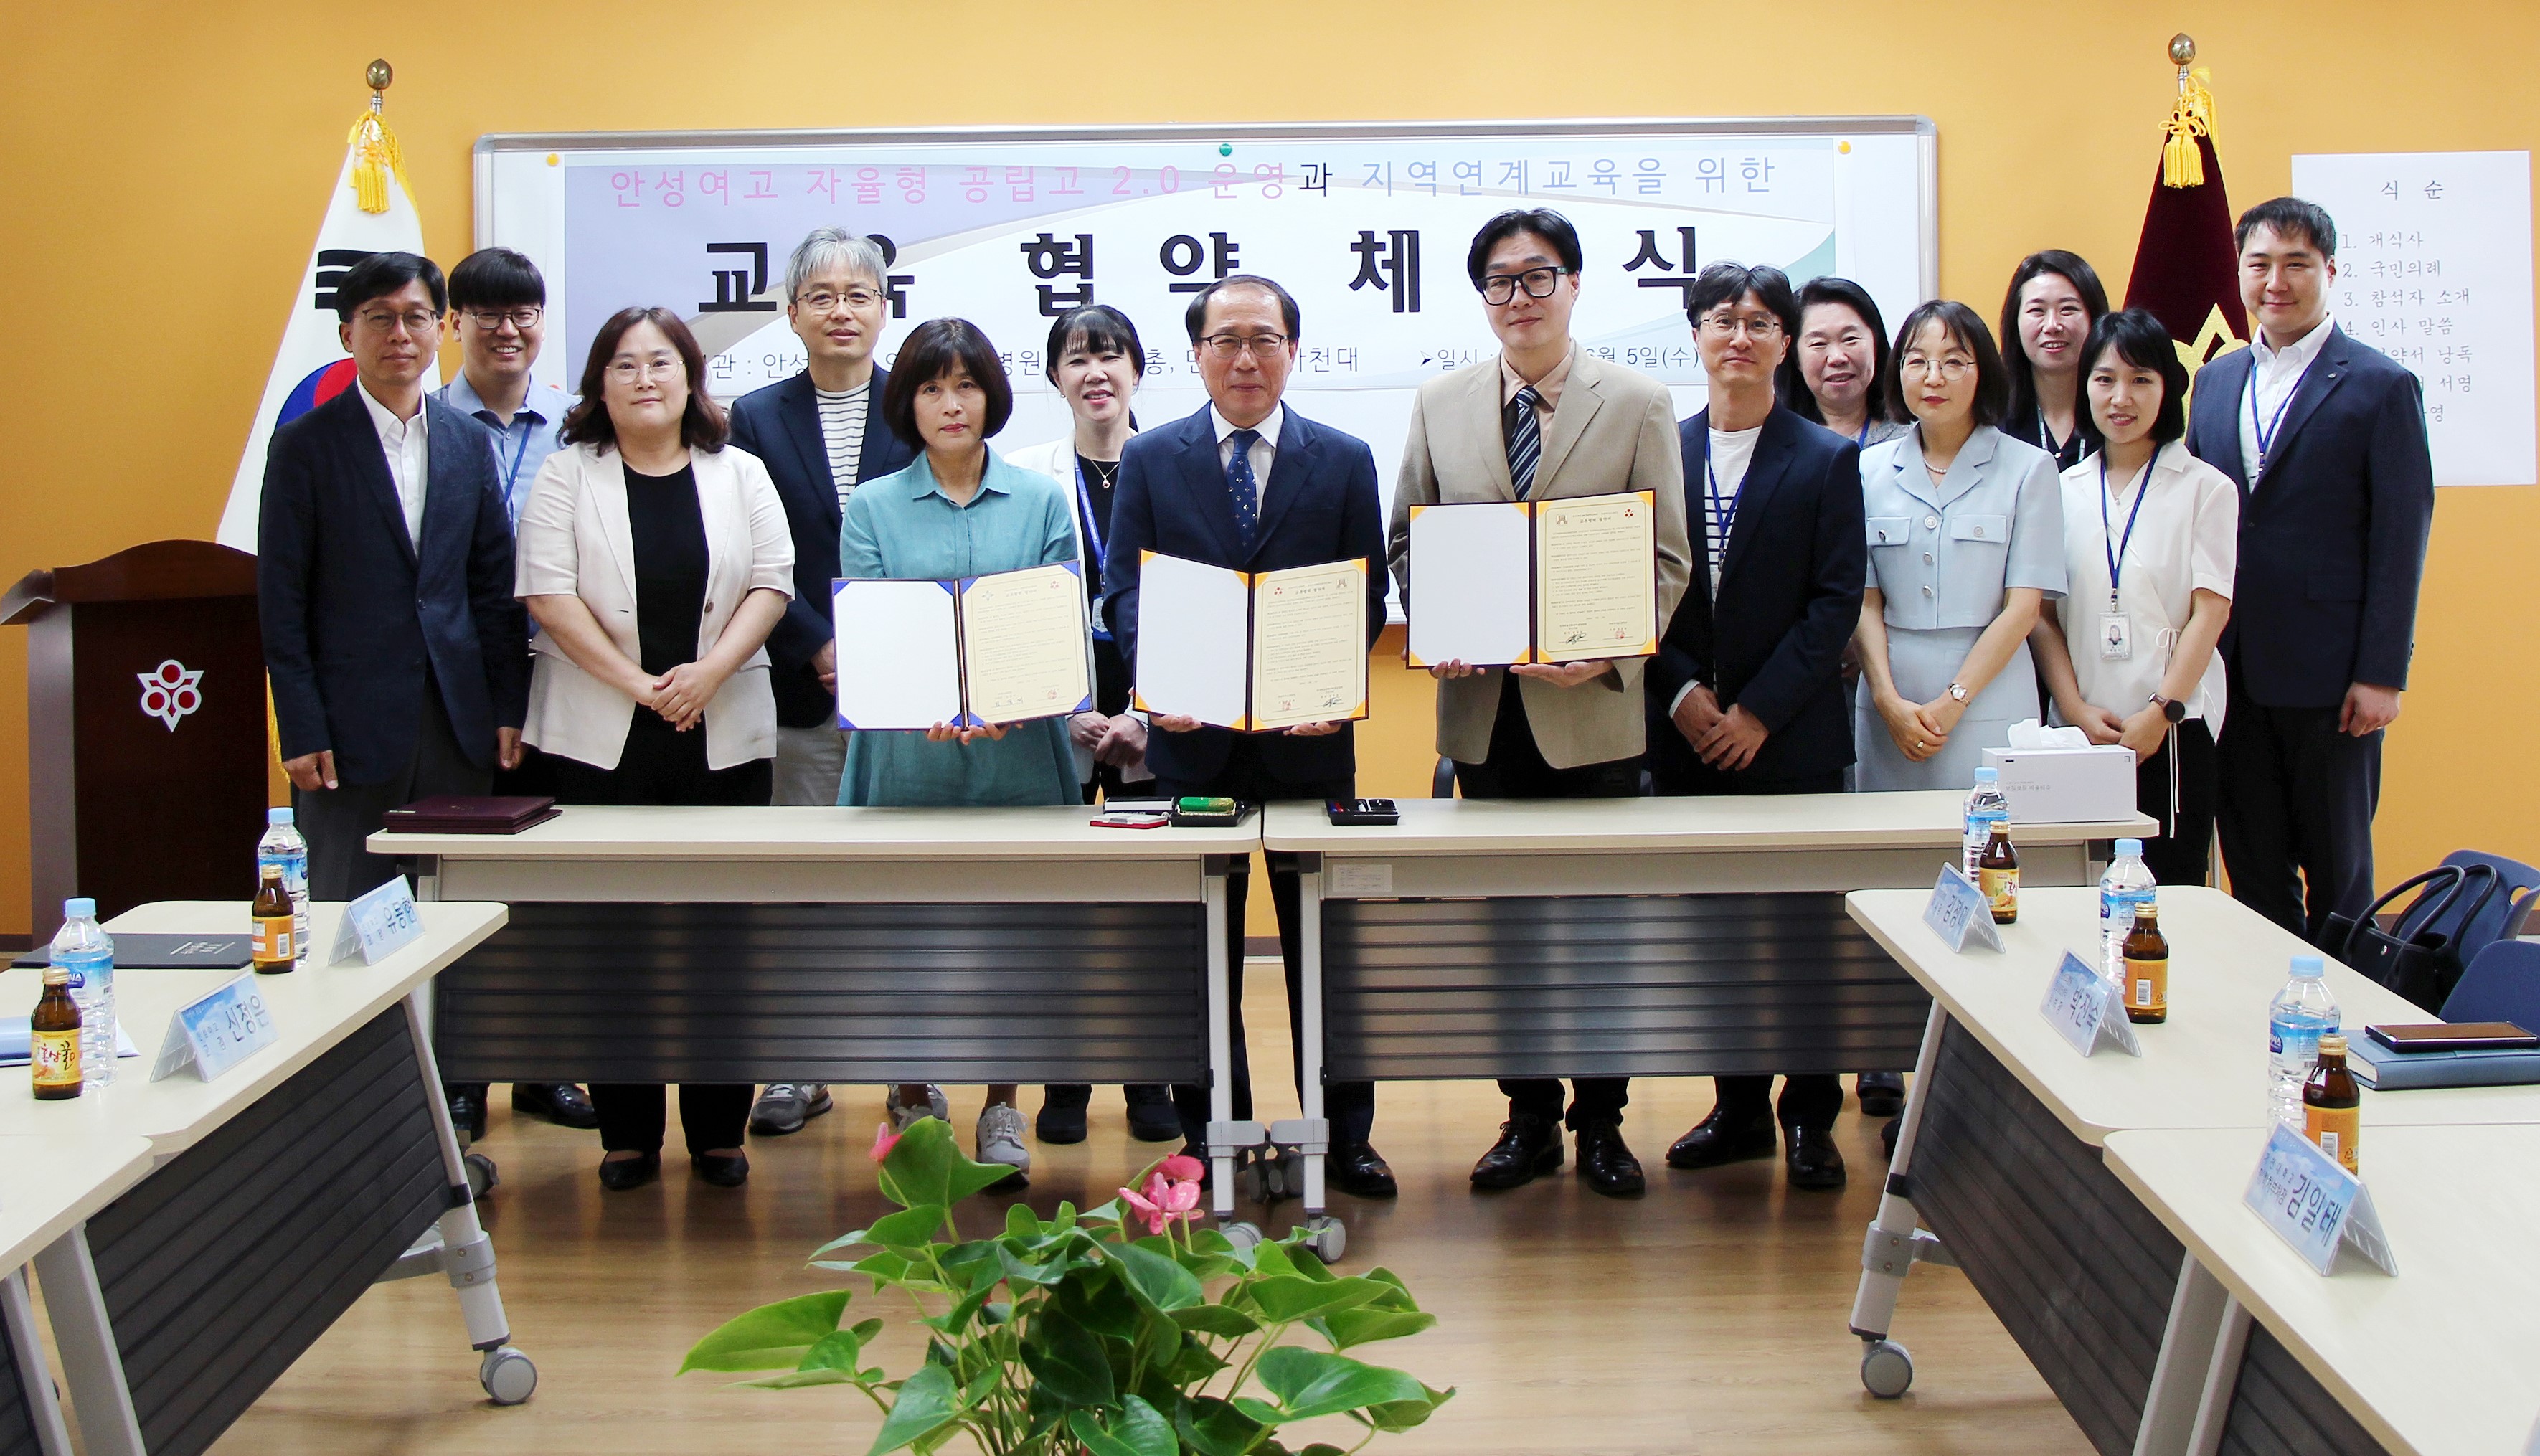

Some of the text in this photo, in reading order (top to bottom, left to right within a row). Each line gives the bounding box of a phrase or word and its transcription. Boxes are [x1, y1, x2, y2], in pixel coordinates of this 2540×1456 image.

[610, 155, 1776, 209] 안성여고 자율형 공립고 2.0 운영과 지역연계교육을 위한
[2342, 231, 2424, 250] 1. 개식사
[2343, 259, 2441, 279] 2. 국민의례
[2344, 288, 2470, 308] 3. 참석자 소개
[2345, 316, 2453, 337] 4. 인사 말씀
[1437, 349, 1478, 371] 일시
[1626, 346, 1699, 369] 5일(수)
[2381, 345, 2473, 364] 약서 낭독
[2439, 374, 2472, 393] 서명
[225, 995, 270, 1042] 신정은
[2069, 987, 2100, 1035] 박진숙
[2286, 1173, 2343, 1247] 김일태
